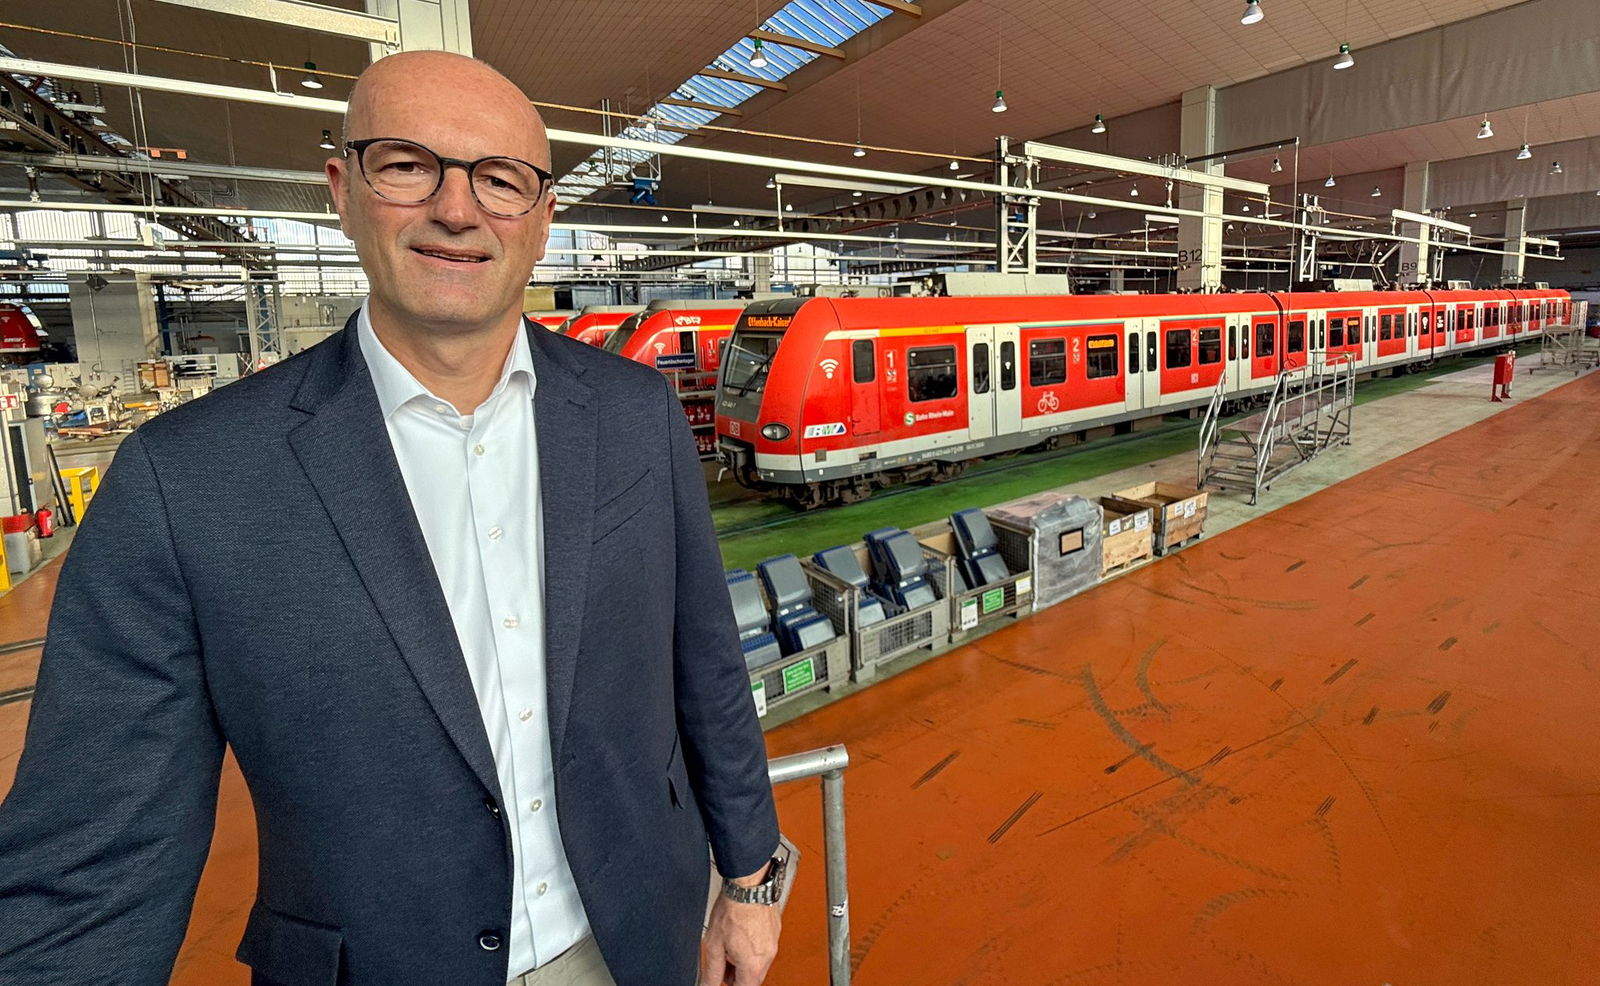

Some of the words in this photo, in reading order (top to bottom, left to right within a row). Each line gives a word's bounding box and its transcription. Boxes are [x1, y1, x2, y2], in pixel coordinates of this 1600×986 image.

[1402, 262, 1417, 271] B9
[1192, 329, 1197, 341] 2
[708, 339, 713, 350] 1
[1073, 338, 1079, 352] 2
[887, 351, 894, 368] 1
[906, 412, 914, 424] S
[730, 421, 740, 435] DB
